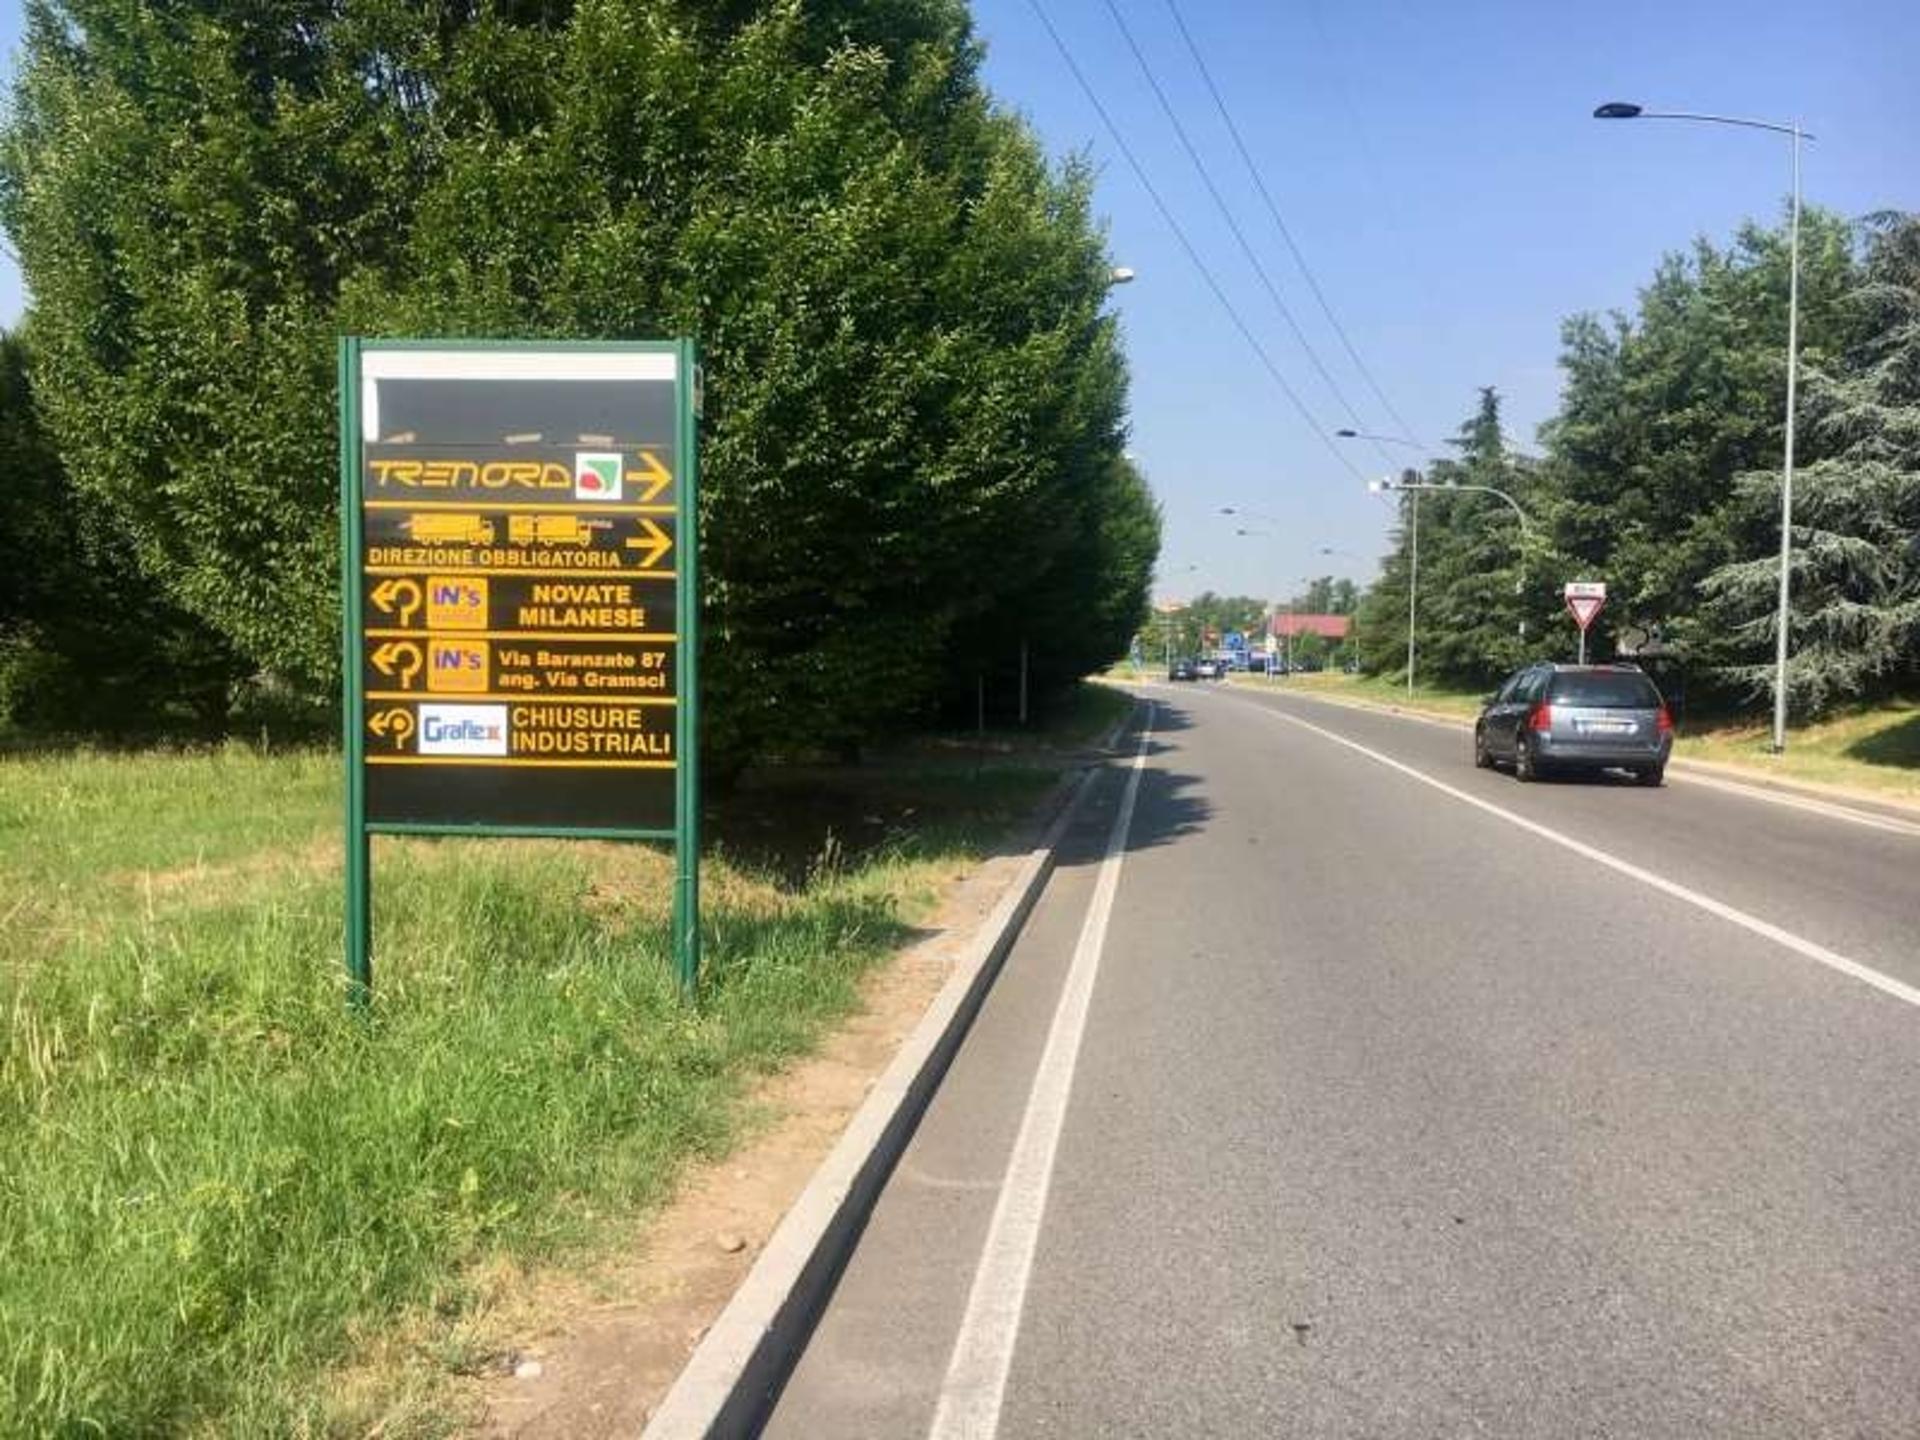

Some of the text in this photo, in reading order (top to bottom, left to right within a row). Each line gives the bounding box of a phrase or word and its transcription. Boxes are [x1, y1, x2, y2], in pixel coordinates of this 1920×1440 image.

[368, 460, 571, 488] TRENORD
[369, 549, 621, 567] DIREZIONE OBBLIGATORIA
[533, 585, 632, 604] NOVATE
[519, 608, 645, 628] MILANESE
[498, 651, 666, 668] Via Baranzate 87
[498, 673, 539, 690] ang.
[547, 671, 578, 687] Via
[583, 672, 666, 688] Gramsci
[512, 707, 641, 728] CHIUSURE
[512, 732, 670, 754] INDUSTRIALI
